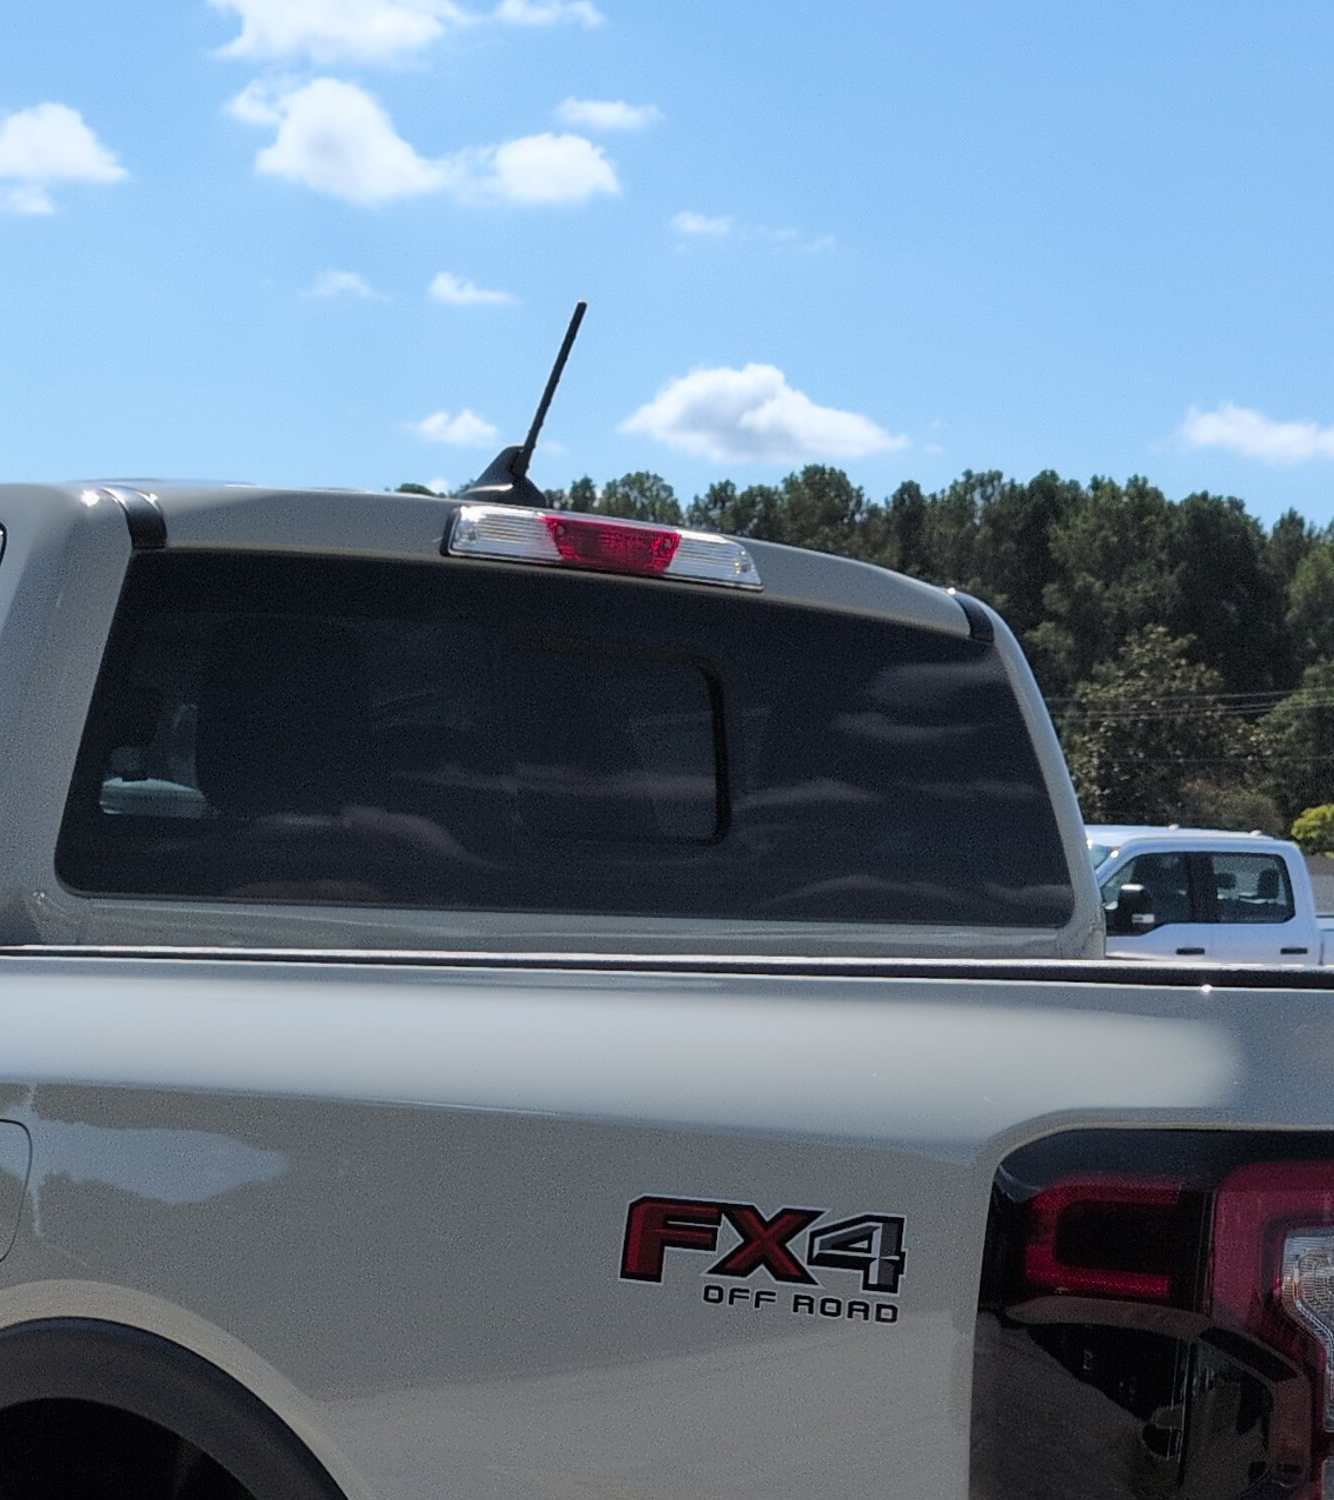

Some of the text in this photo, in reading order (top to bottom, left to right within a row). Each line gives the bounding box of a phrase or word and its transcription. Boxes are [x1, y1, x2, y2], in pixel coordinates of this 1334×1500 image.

[619, 1194, 906, 1296] FX4
[703, 1284, 900, 1325] OFF ROAD
